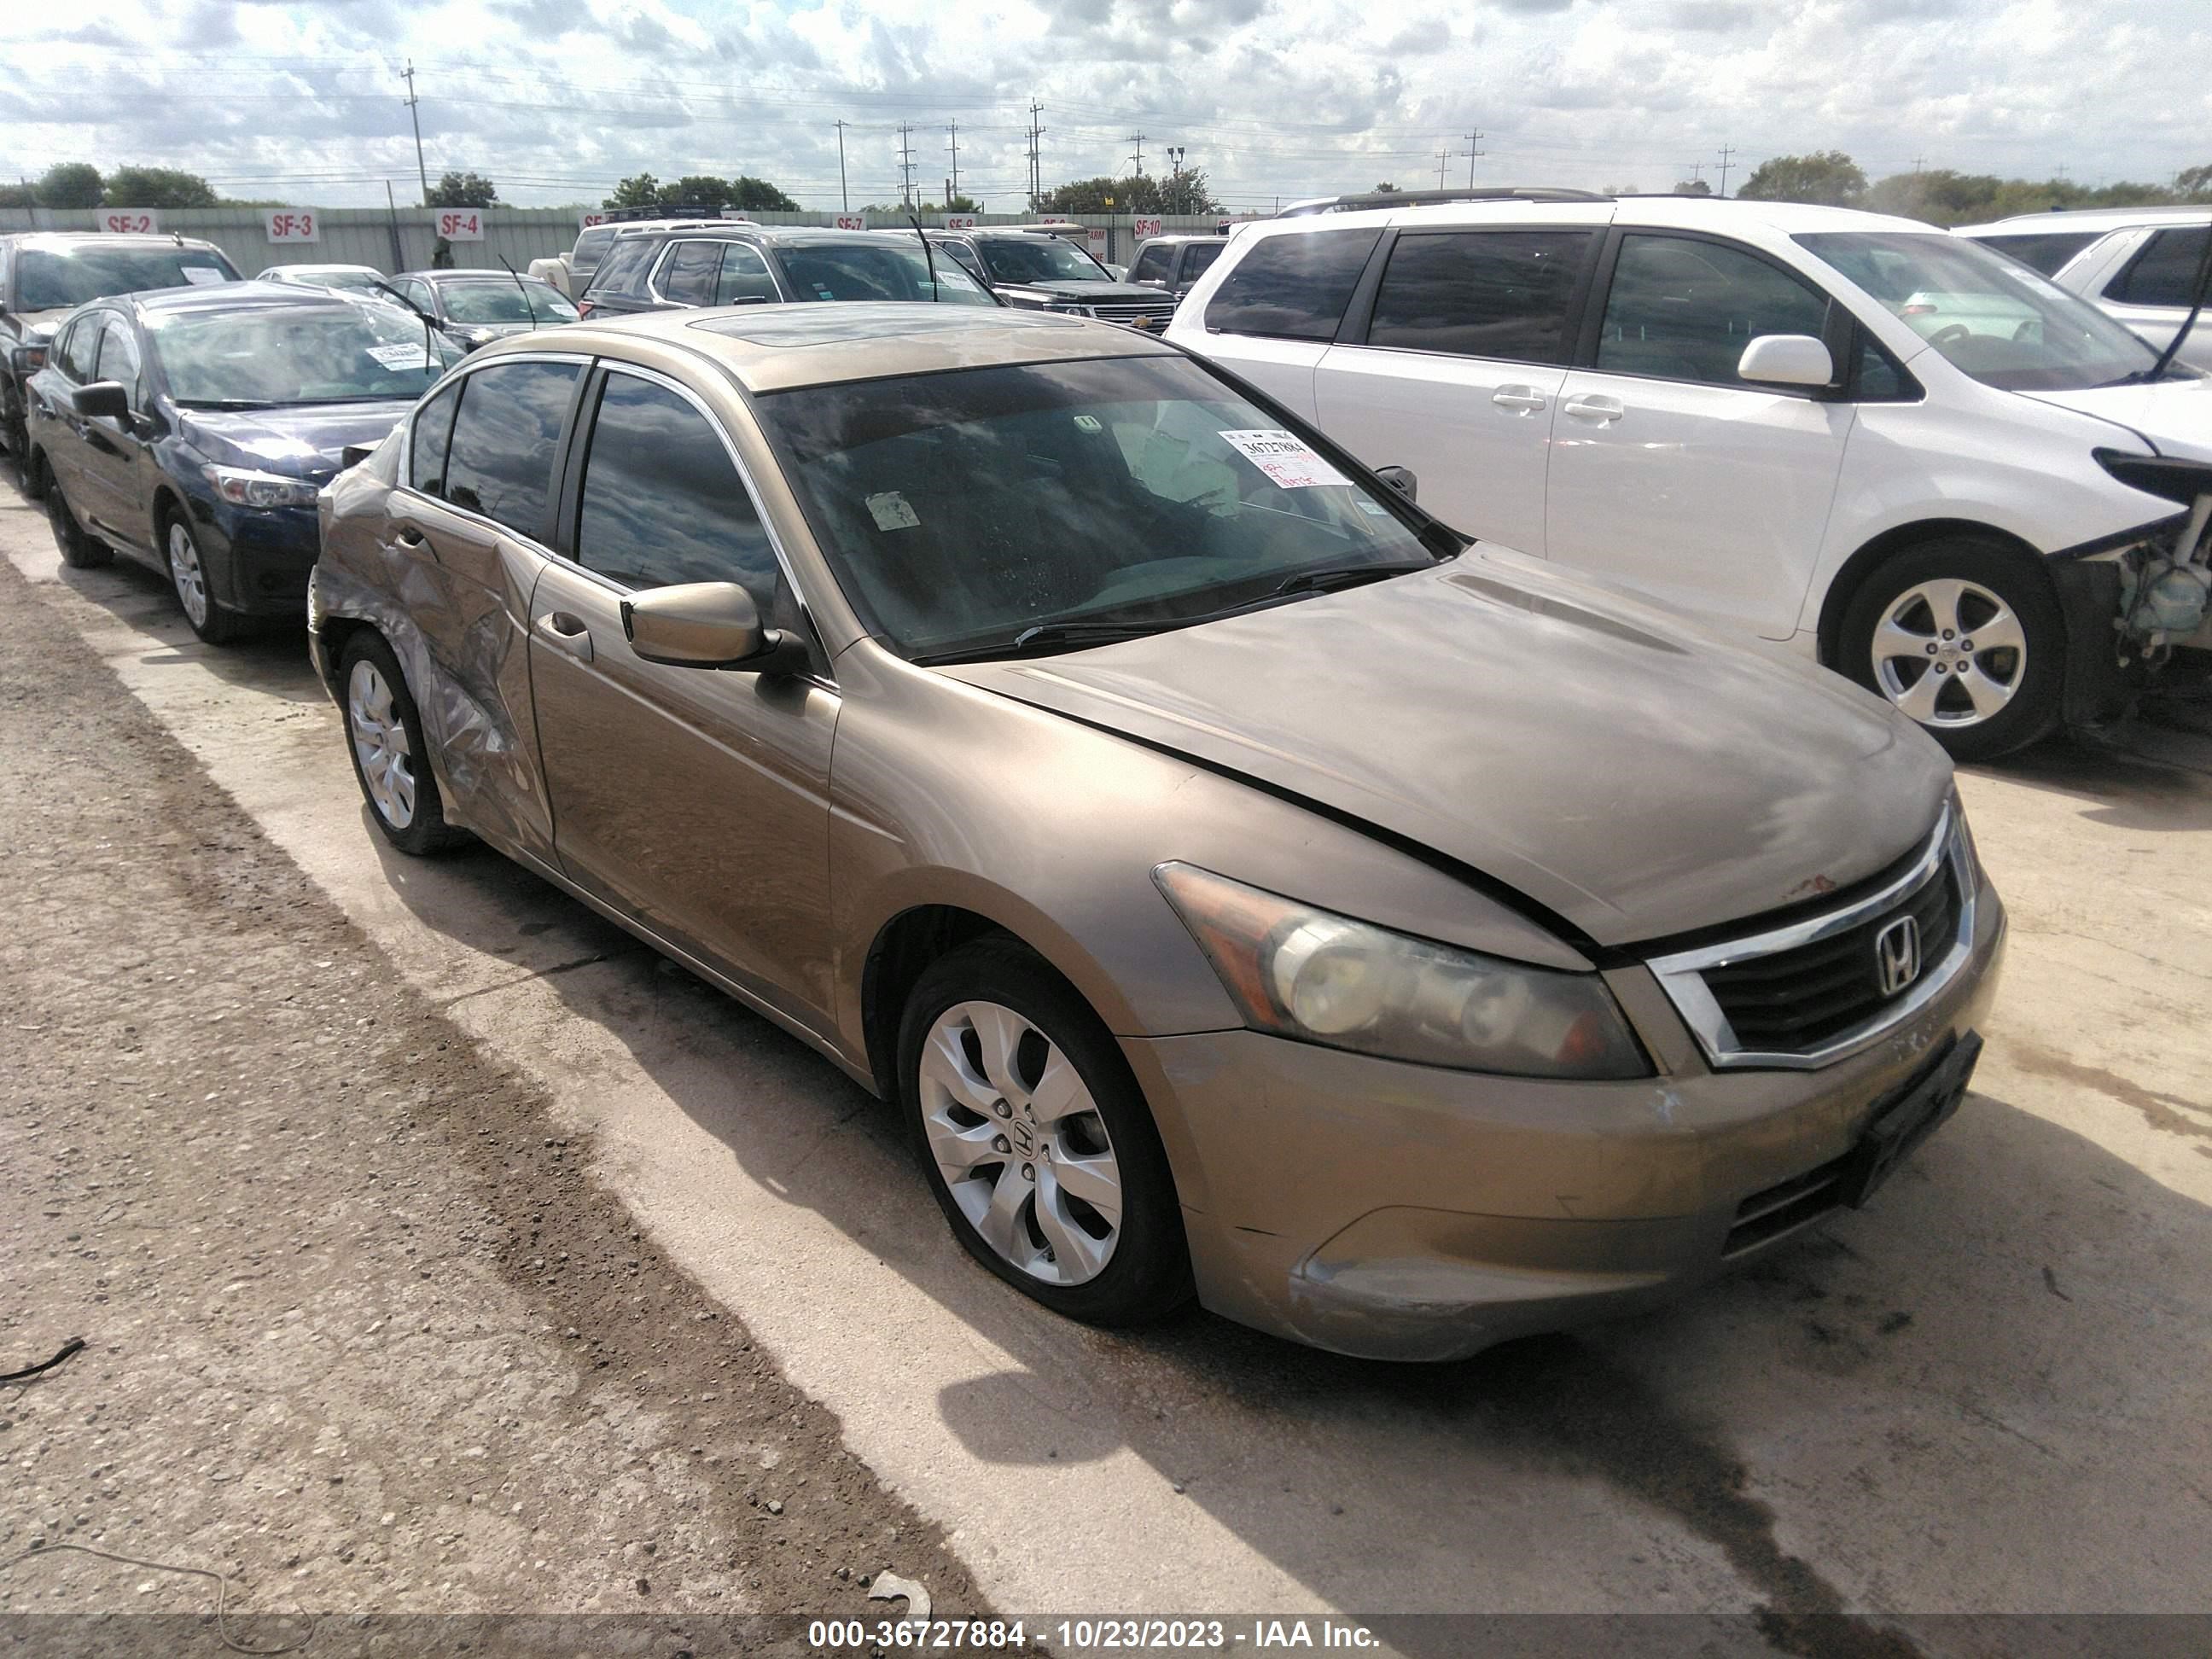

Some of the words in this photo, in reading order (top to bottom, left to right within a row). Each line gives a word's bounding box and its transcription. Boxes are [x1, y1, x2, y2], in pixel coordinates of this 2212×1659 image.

[108, 216, 150, 233] SF-2
[272, 215, 311, 236] SF-3
[440, 214, 478, 235] SF-4
[1135, 219, 1161, 236] SF-10
[1242, 442, 1306, 454] 36727884
